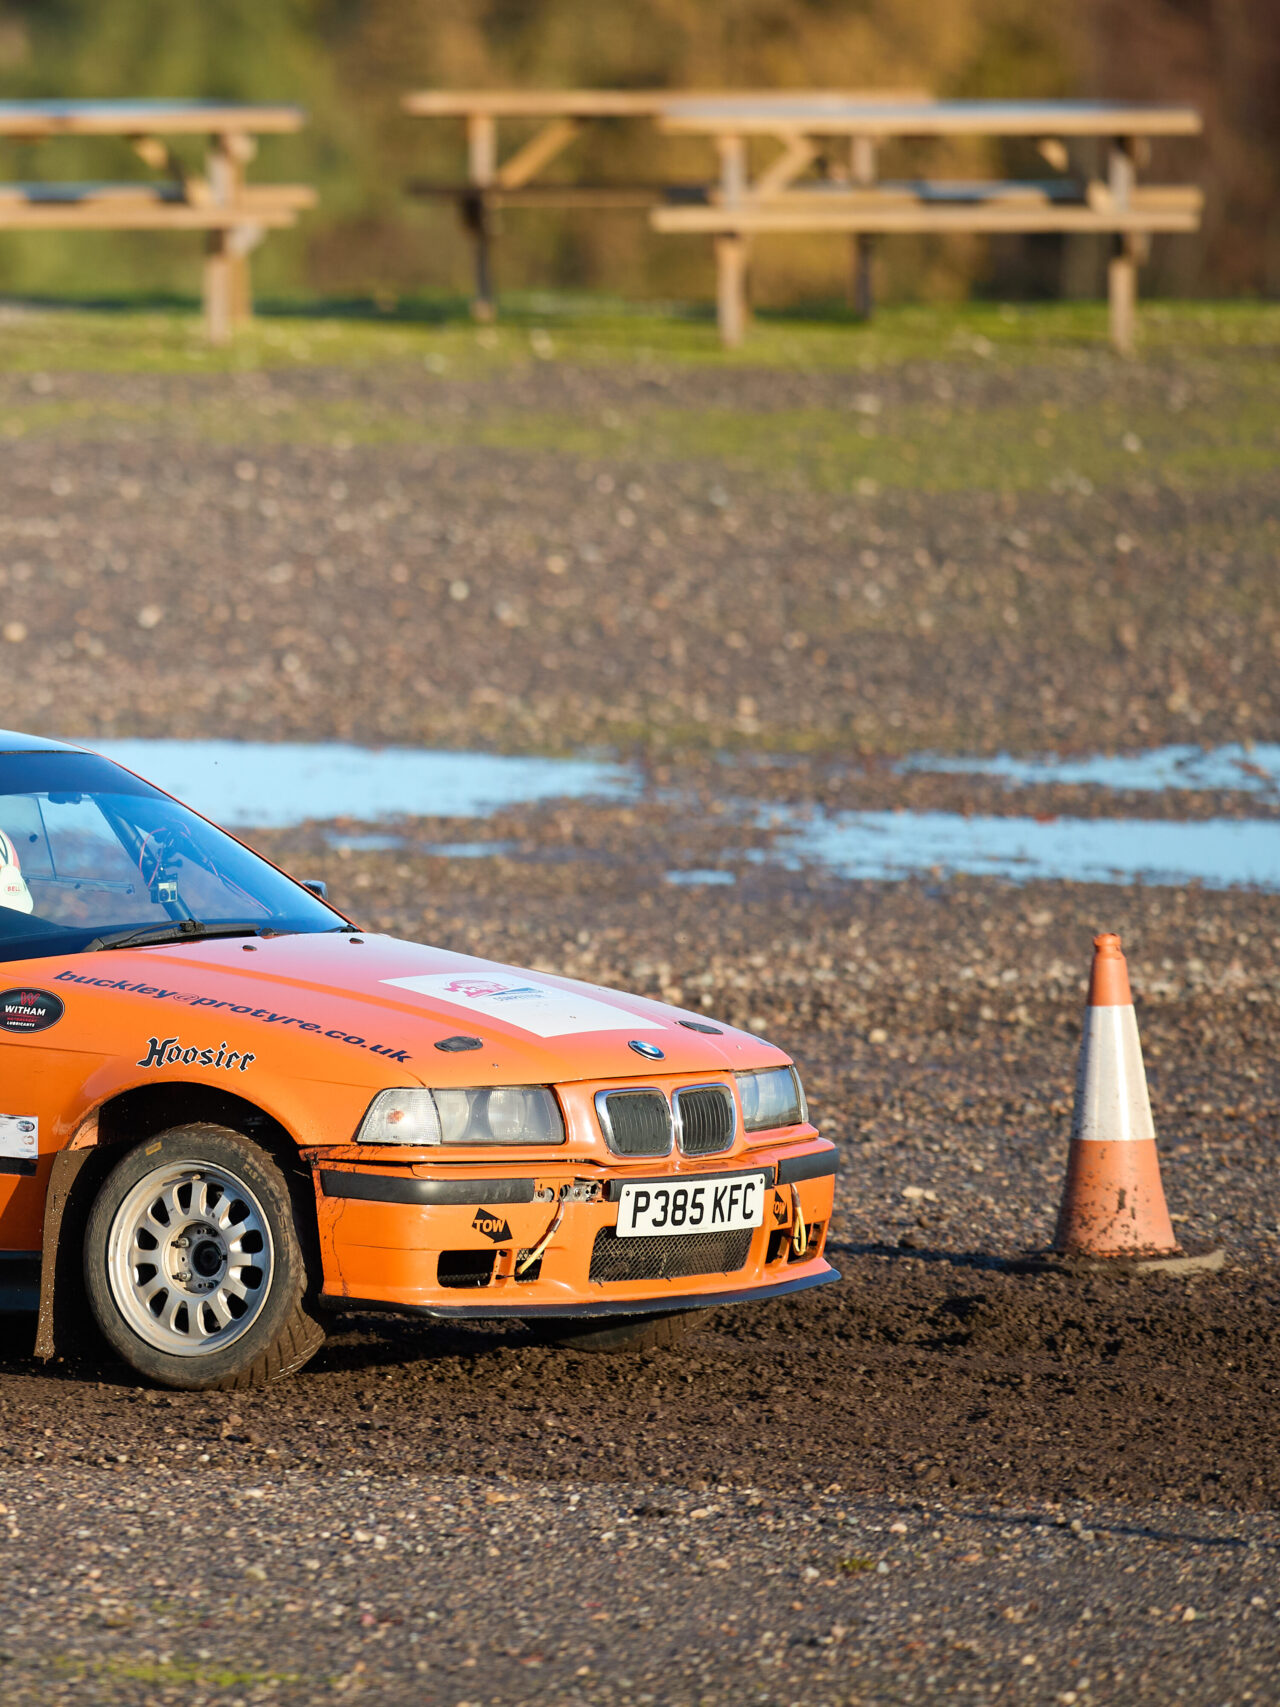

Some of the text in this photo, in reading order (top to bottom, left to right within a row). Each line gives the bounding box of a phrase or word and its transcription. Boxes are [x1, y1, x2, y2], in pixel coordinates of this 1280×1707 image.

[4, 1005, 46, 1016] WITHAM
[54, 970, 413, 1063] buckley@protyre.co.uk
[136, 1036, 256, 1072] Hoosier
[631, 1182, 756, 1228] P385 KFC
[473, 1219, 505, 1232] TOW
